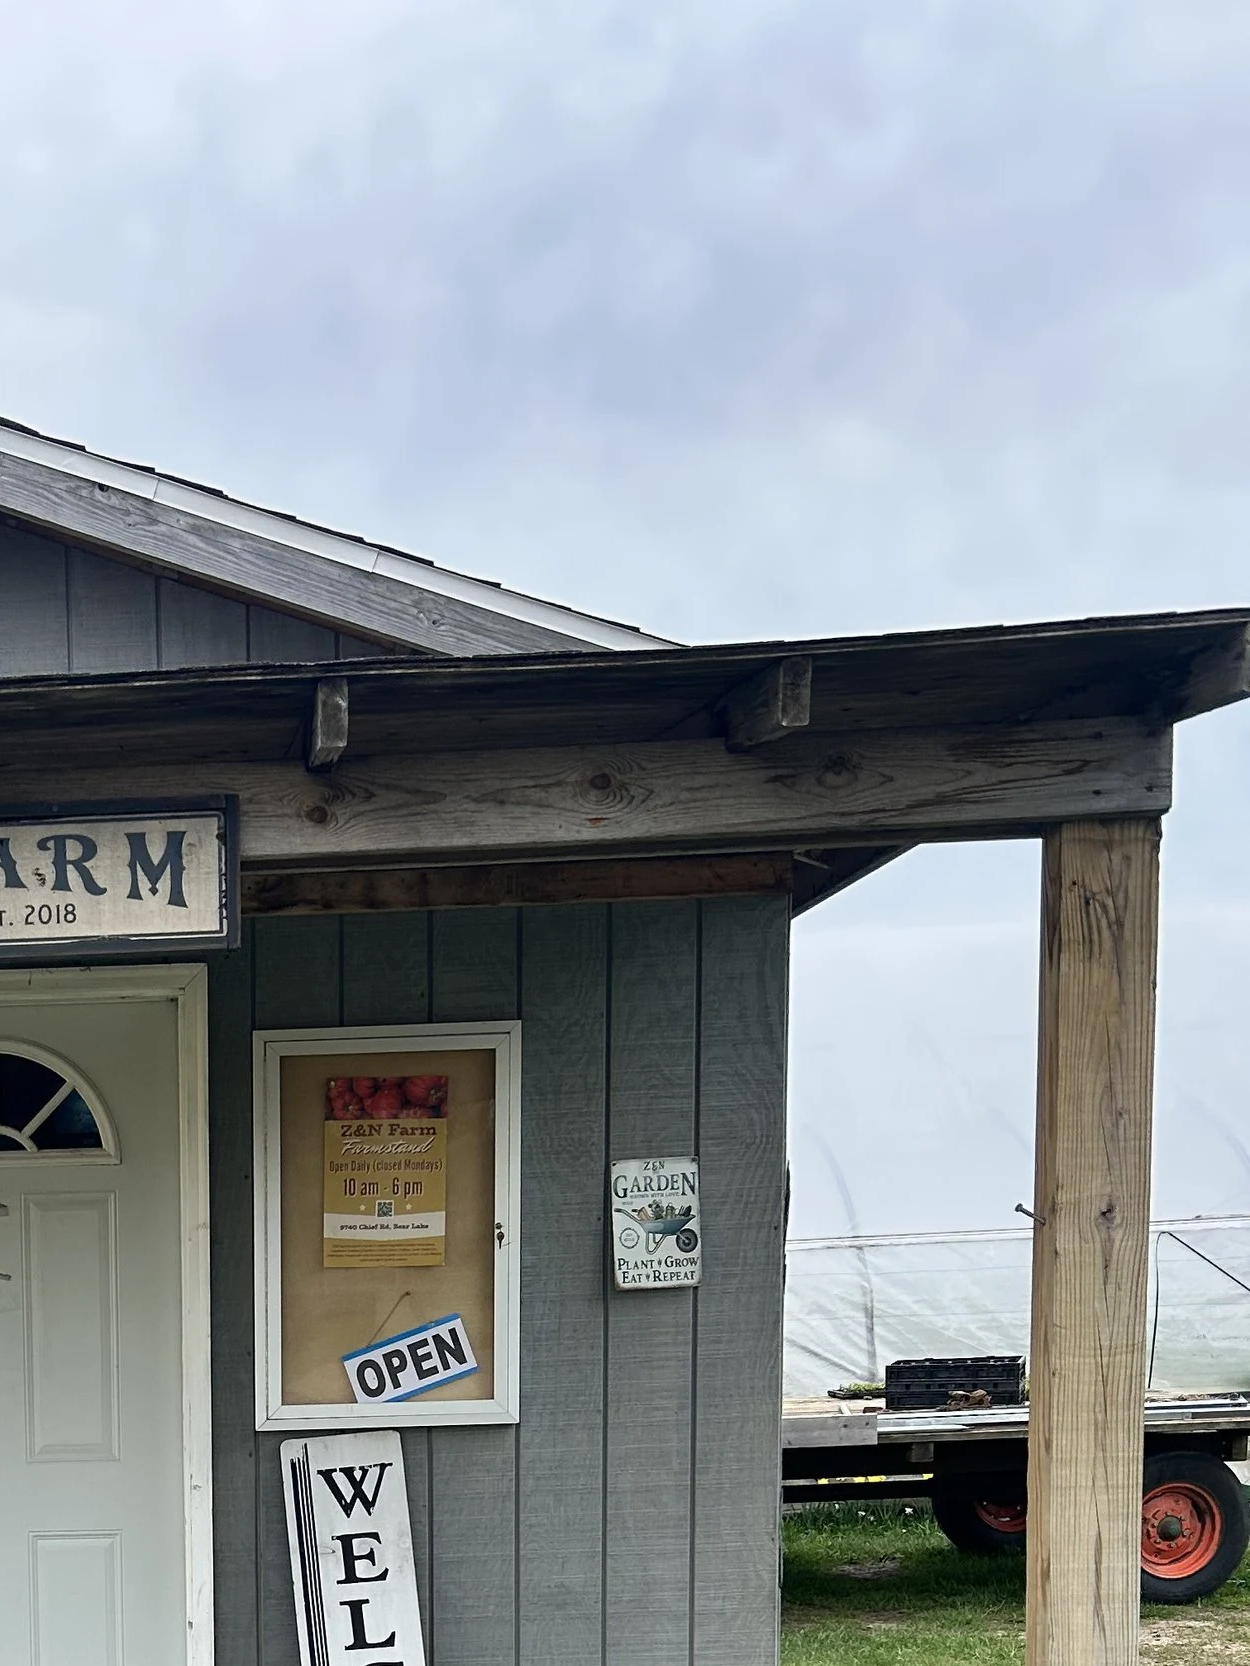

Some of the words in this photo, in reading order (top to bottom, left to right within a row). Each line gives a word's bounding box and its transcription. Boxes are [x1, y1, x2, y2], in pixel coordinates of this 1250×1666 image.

[23, 903, 78, 926] 2018
[340, 1123, 383, 1138] Z&N
[387, 1122, 437, 1137] Farm
[340, 1136, 436, 1156] Farmstand
[329, 1160, 349, 1174] Open
[351, 1160, 371, 1175] Daily
[372, 1158, 402, 1173] (closed
[404, 1158, 443, 1174] Mondays)
[343, 1177, 357, 1197] 10
[360, 1181, 380, 1197] am
[392, 1177, 400, 1196] 6
[403, 1180, 424, 1200] pm
[613, 1172, 696, 1198] GARDEN
[340, 1223, 358, 1231] 9740
[358, 1223, 379, 1231] Chief
[411, 1222, 430, 1230] Lake
[617, 1257, 655, 1271] PLANT
[664, 1255, 700, 1268] GROW
[622, 1271, 643, 1284] EAT
[652, 1269, 696, 1282] REPEAT
[356, 1327, 468, 1398] OPEN
